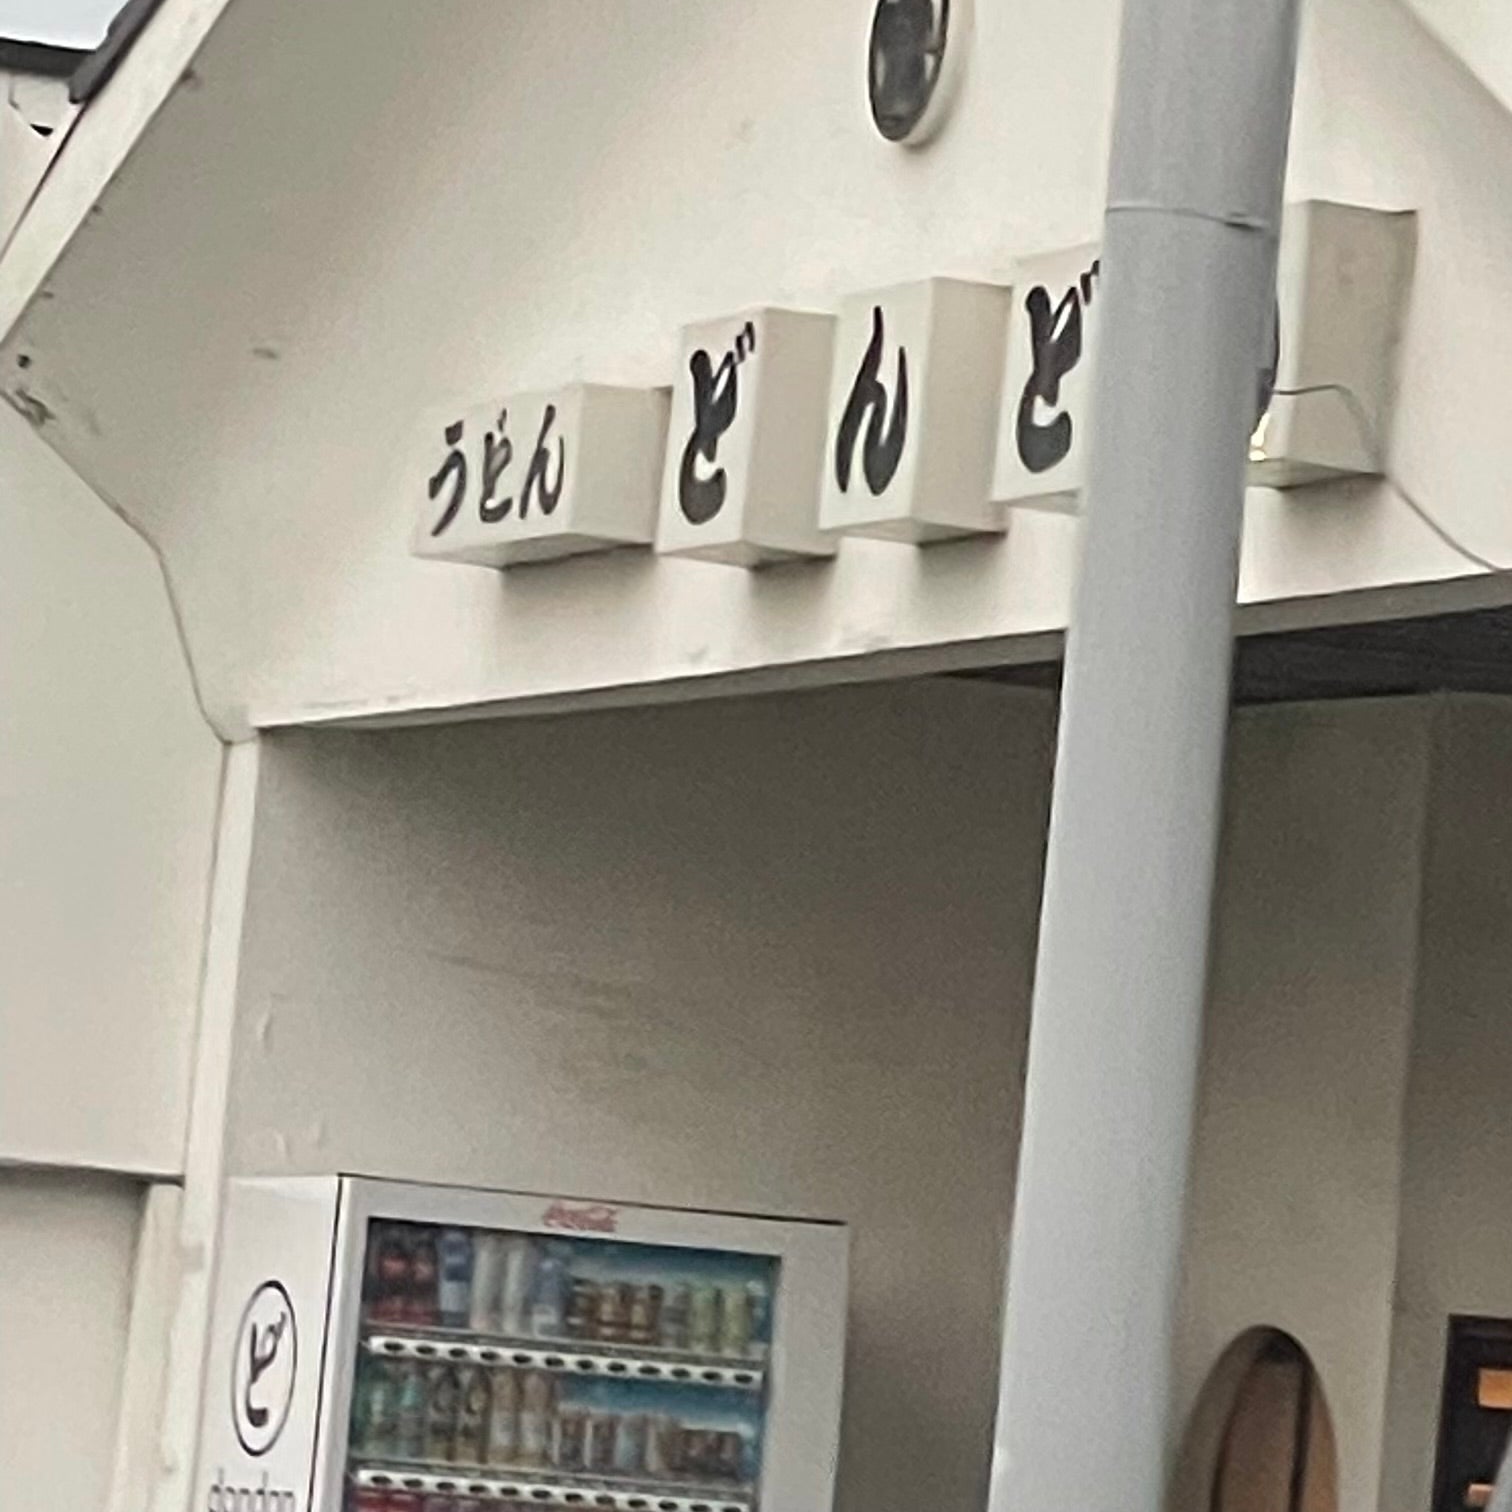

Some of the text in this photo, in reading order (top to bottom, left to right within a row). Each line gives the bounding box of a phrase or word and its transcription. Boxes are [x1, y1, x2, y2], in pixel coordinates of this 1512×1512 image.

[428, 259, 1281, 537] うどん どんど
